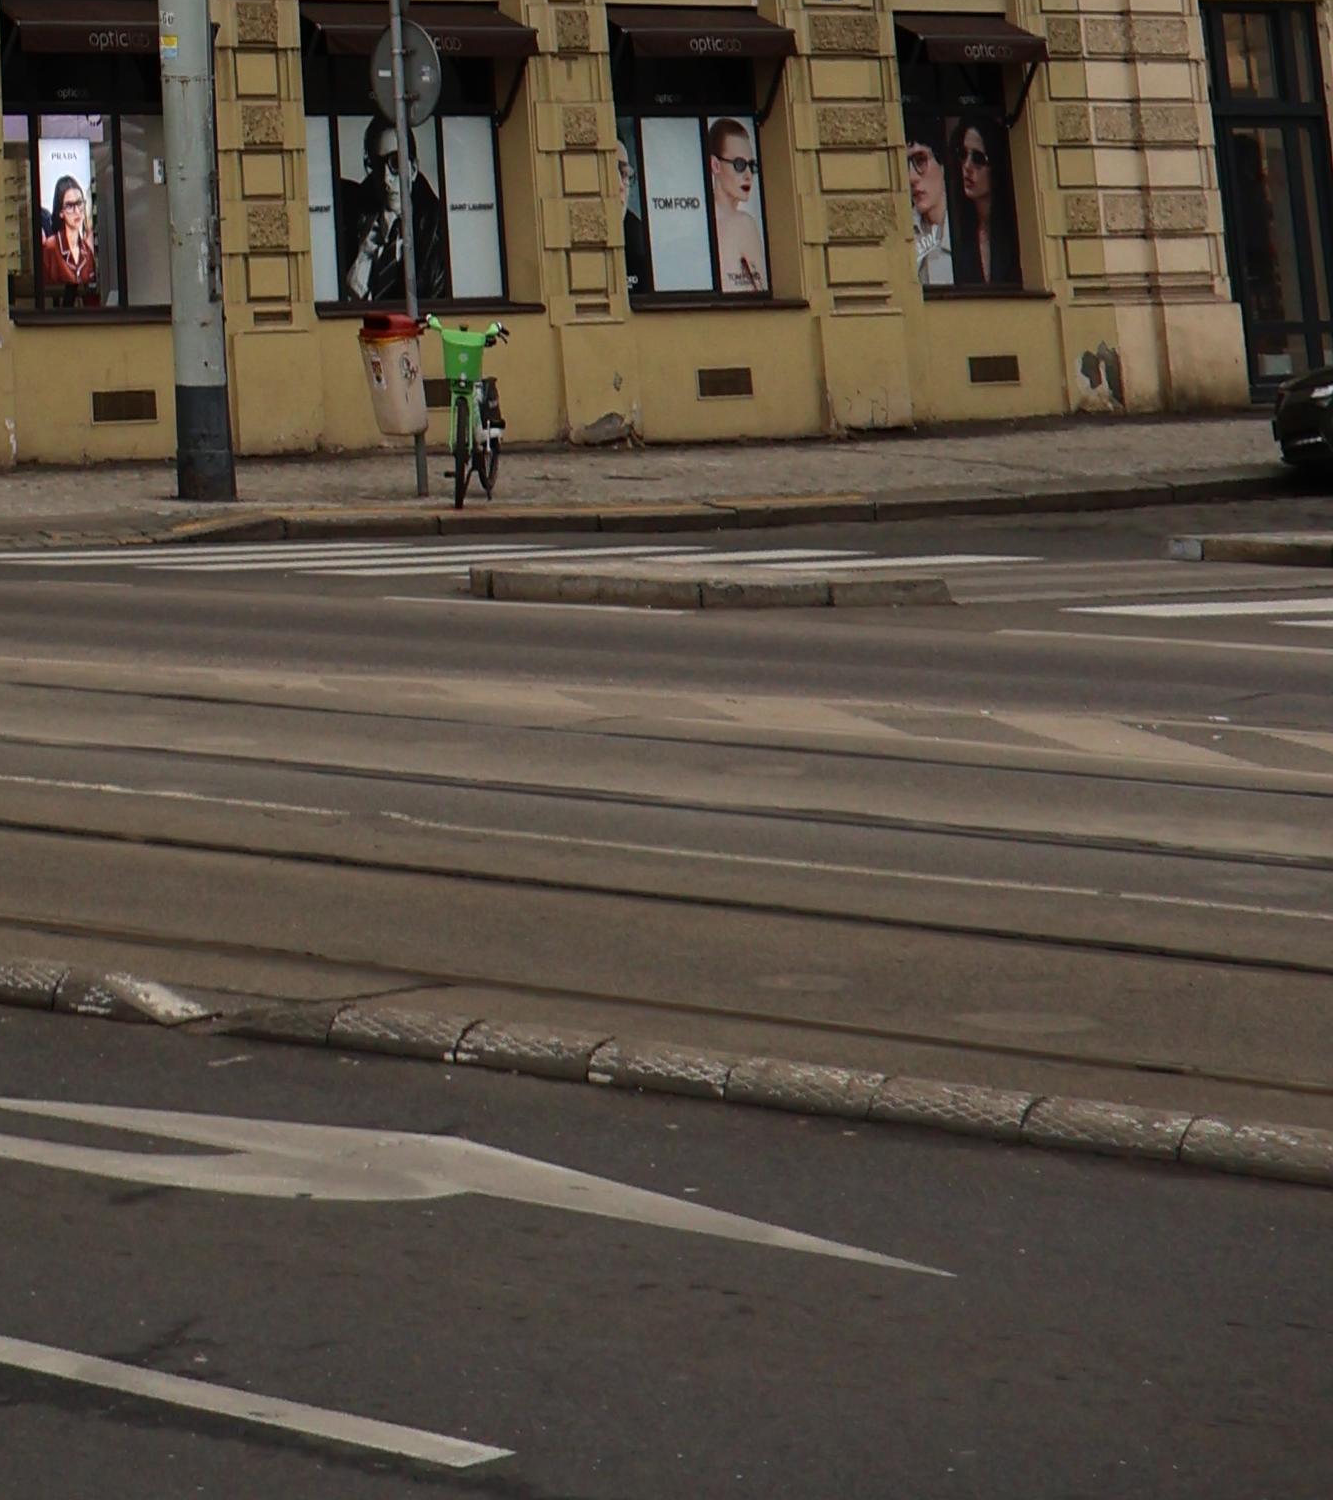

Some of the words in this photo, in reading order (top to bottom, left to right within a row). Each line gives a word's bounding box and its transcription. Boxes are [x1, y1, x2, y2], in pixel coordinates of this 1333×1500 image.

[51, 152, 77, 161] PRADA
[652, 197, 673, 210] TOM
[674, 197, 700, 210] FORD
